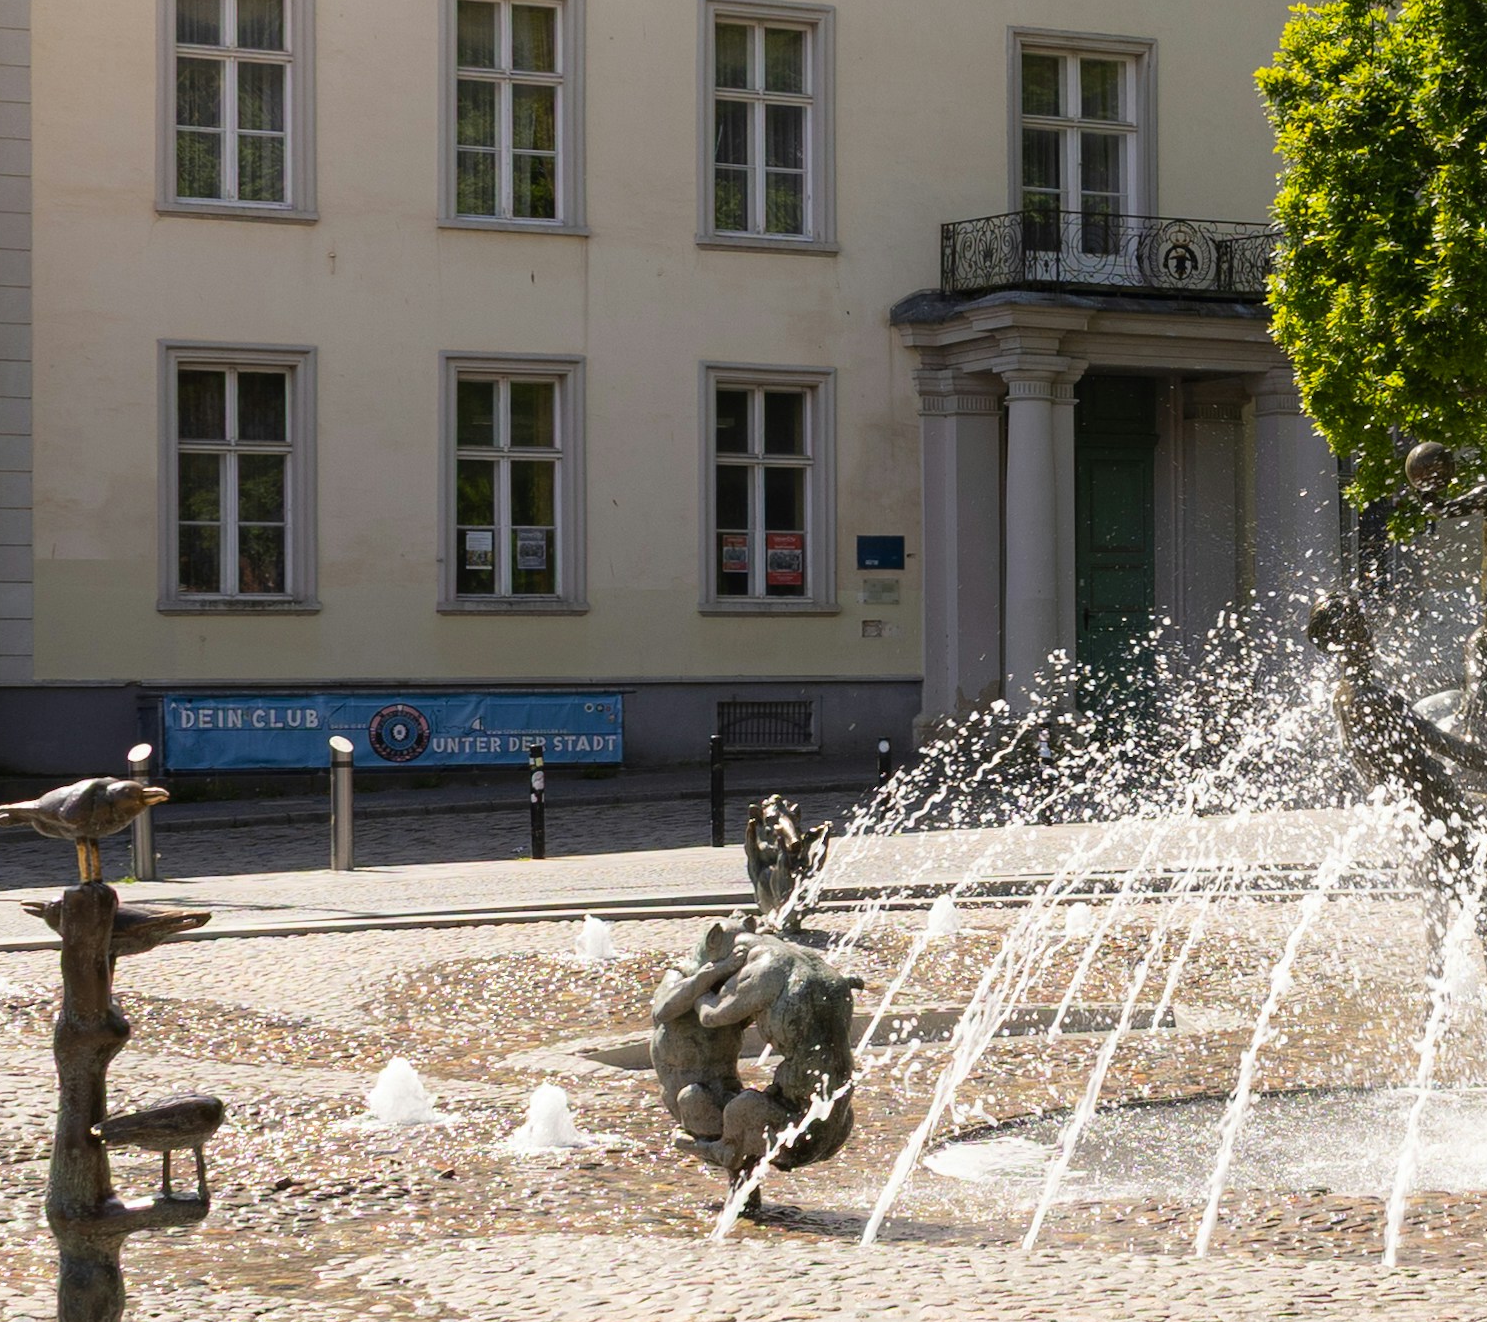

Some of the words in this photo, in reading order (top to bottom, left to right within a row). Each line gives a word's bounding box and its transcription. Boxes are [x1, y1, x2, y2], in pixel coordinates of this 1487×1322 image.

[180, 709, 242, 729] DEIN
[251, 708, 319, 729] CLUB
[432, 737, 502, 753] UNTER
[508, 735, 546, 753] DER
[553, 735, 618, 752] STADT
